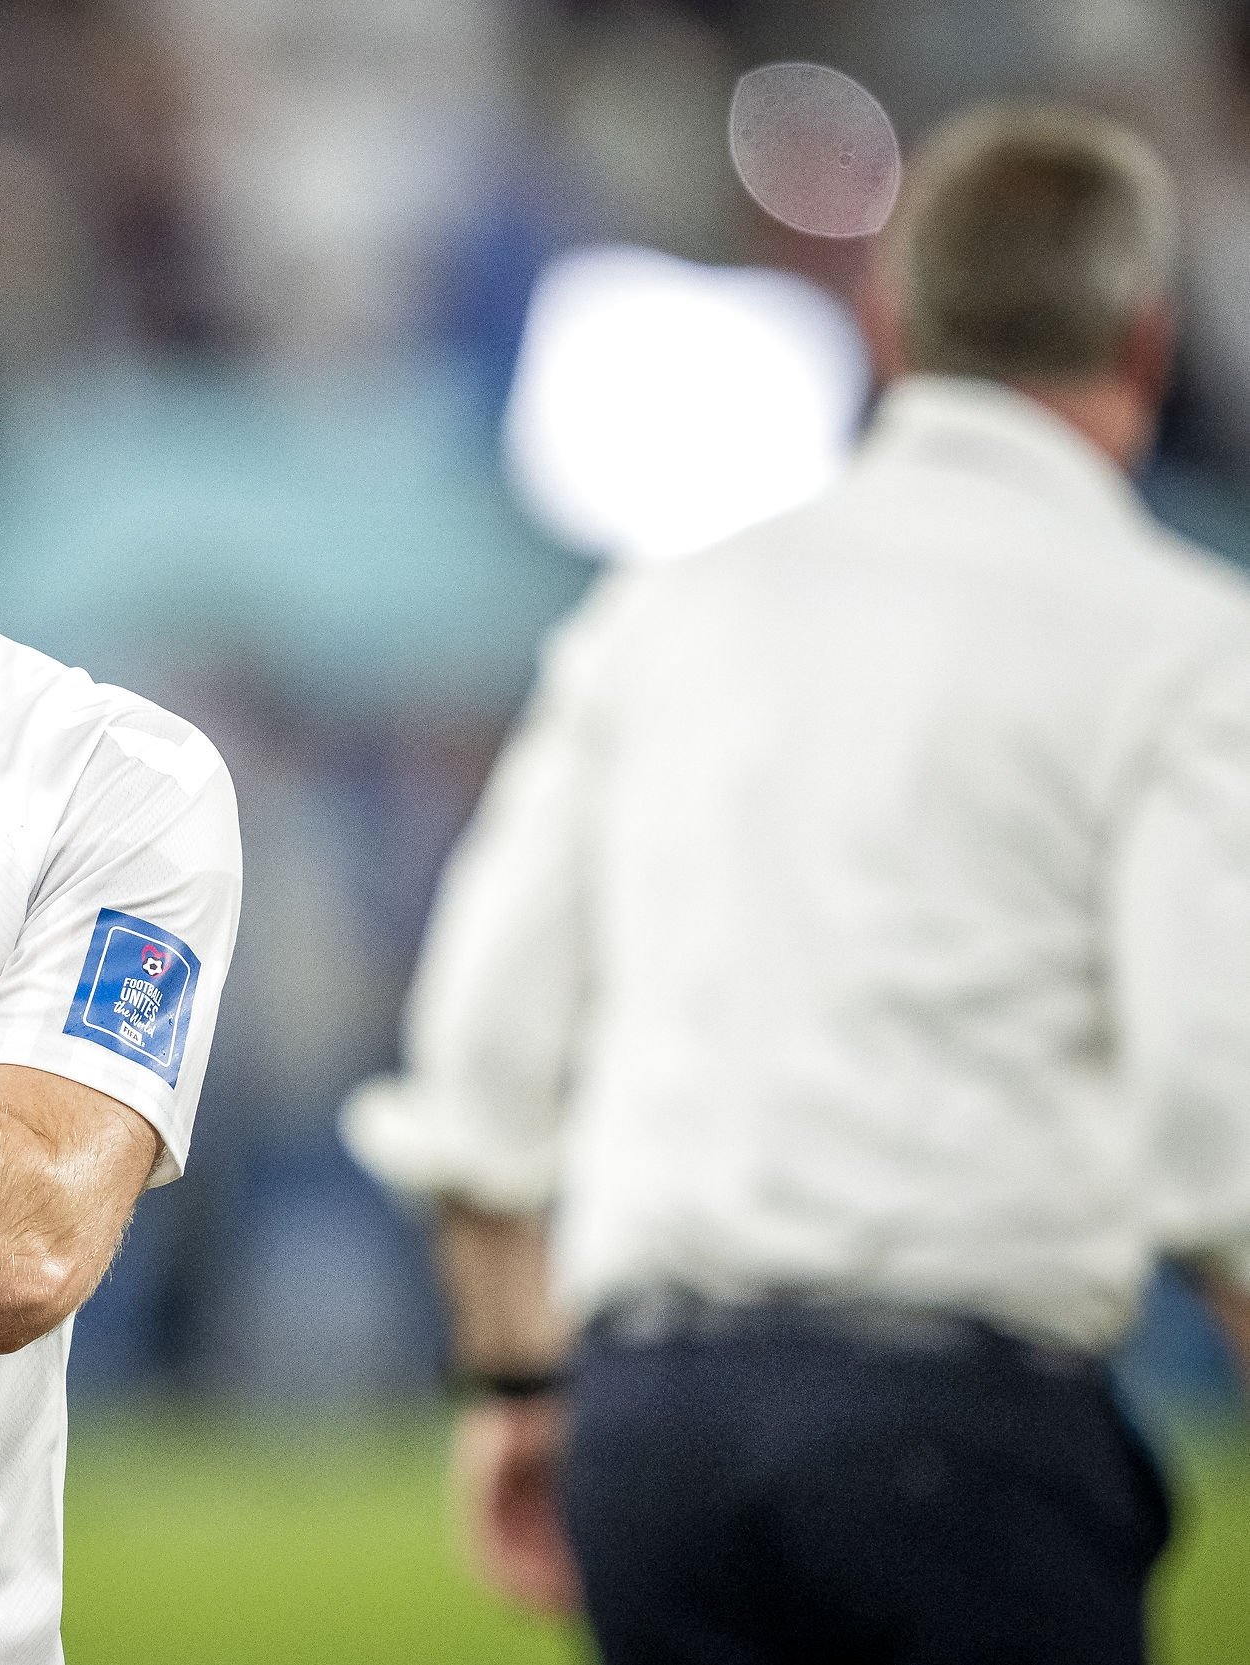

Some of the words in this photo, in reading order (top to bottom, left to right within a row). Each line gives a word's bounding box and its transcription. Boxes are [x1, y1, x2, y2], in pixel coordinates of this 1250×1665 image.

[120, 987, 159, 1022] UNITES
[123, 977, 163, 1007] FOOTBALL
[113, 1000, 131, 1018] the
[129, 1009, 156, 1039] World
[124, 1026, 139, 1042] FIFA
